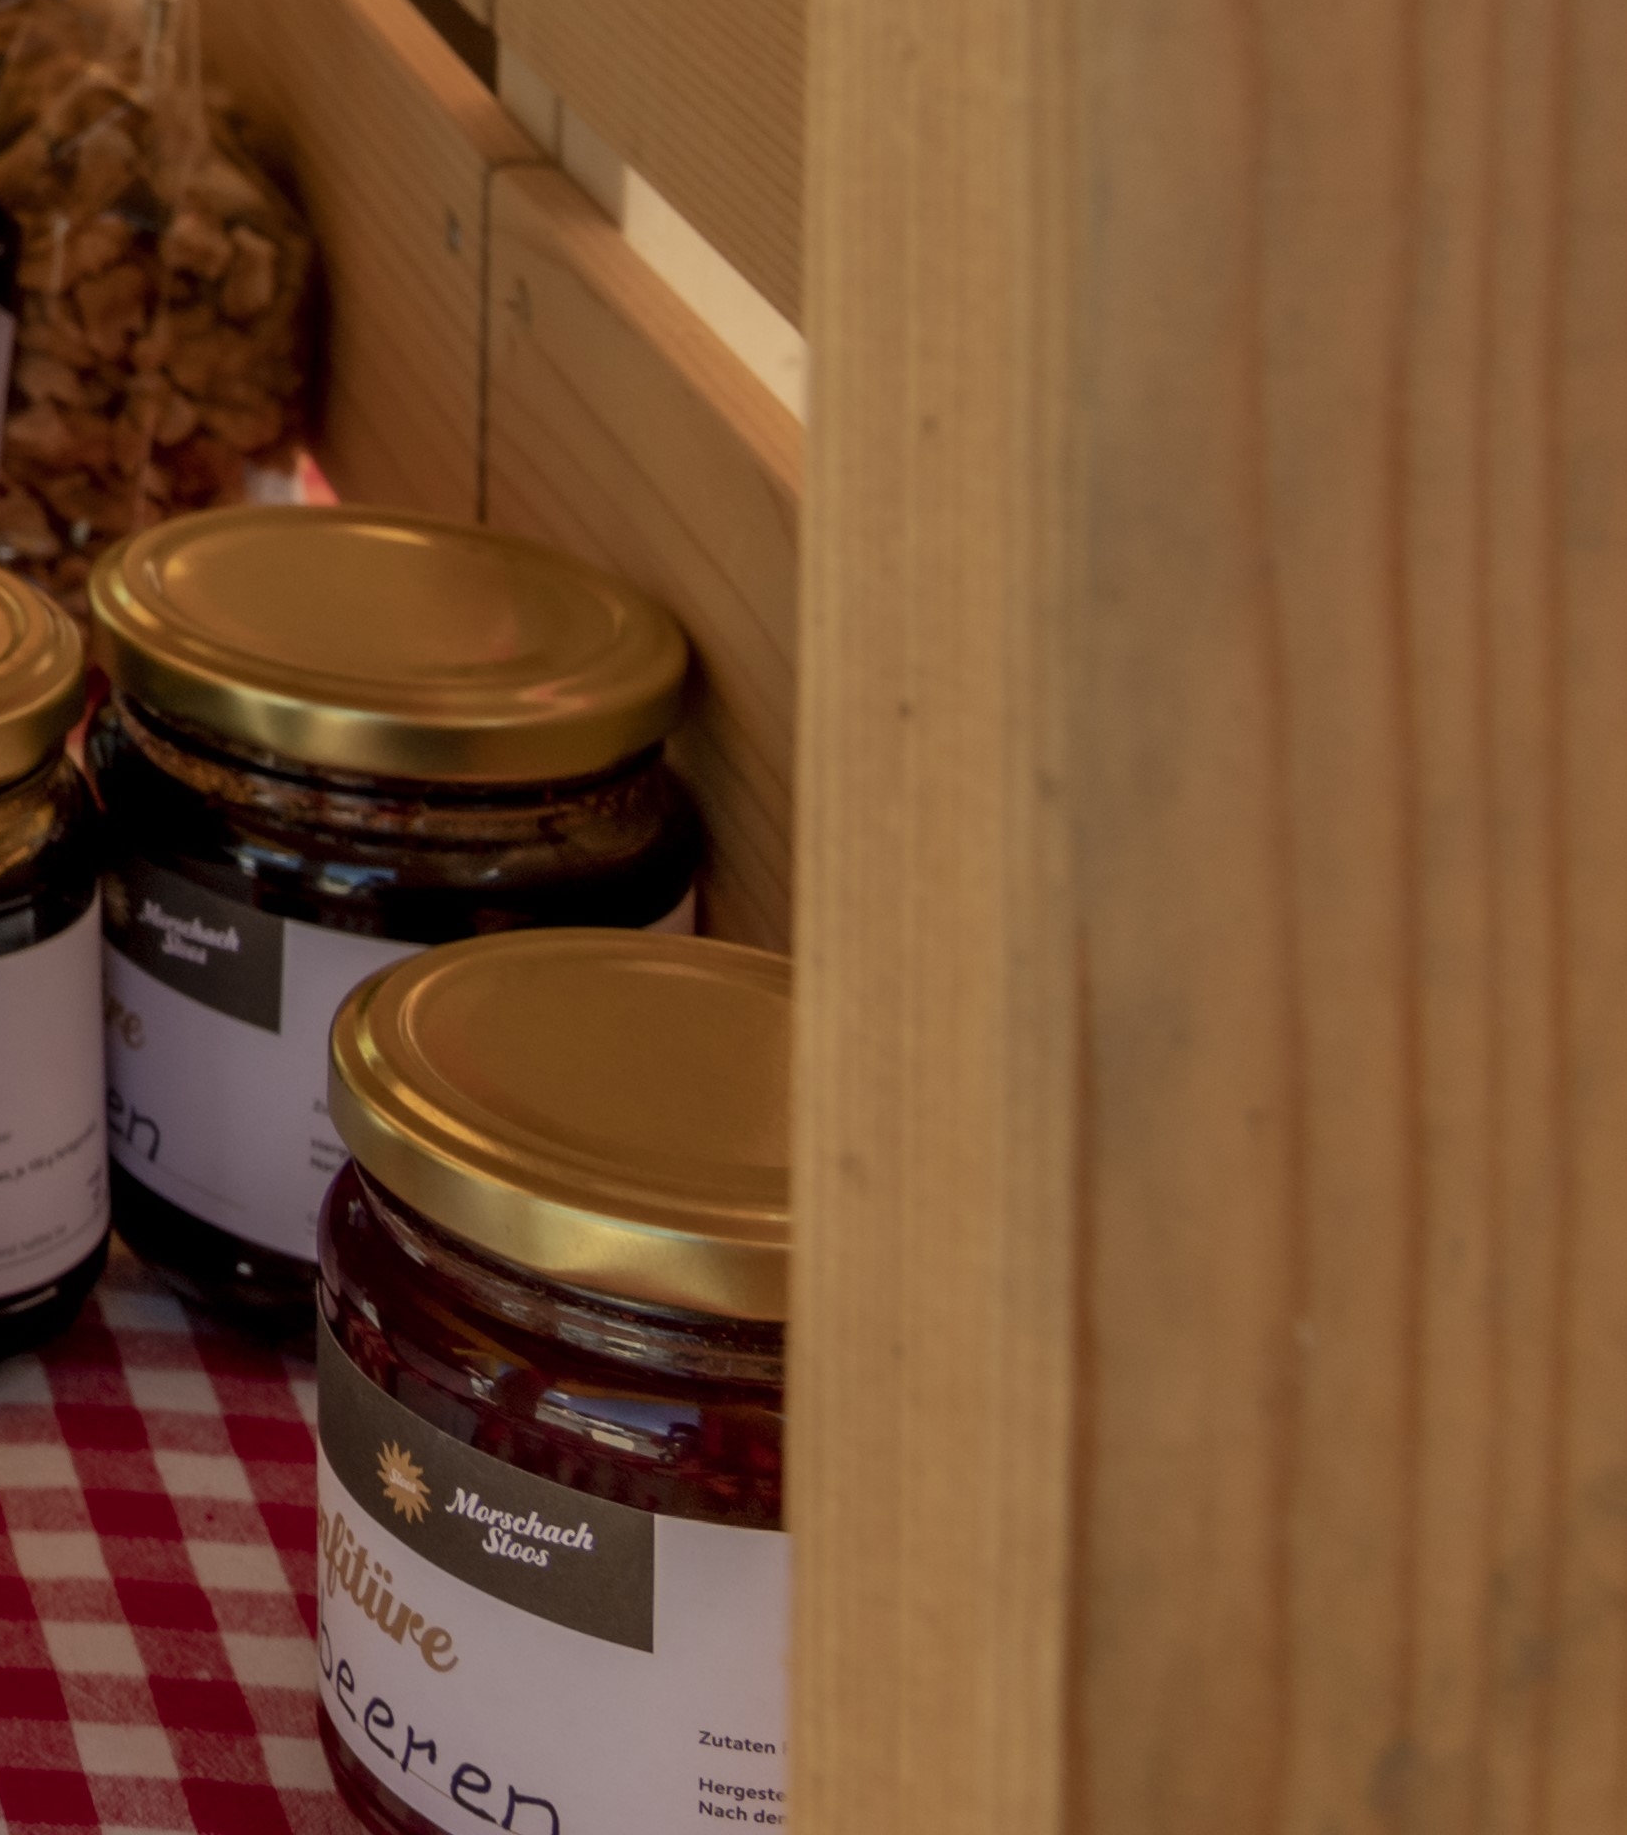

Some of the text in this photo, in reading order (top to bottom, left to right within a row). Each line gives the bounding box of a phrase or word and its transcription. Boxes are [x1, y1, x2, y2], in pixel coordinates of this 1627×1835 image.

[445, 1487, 594, 1551] Morschach
[481, 1527, 550, 1568] Stoos
[698, 1730, 776, 1754] Zutaten
[698, 1800, 748, 1822] Nach
